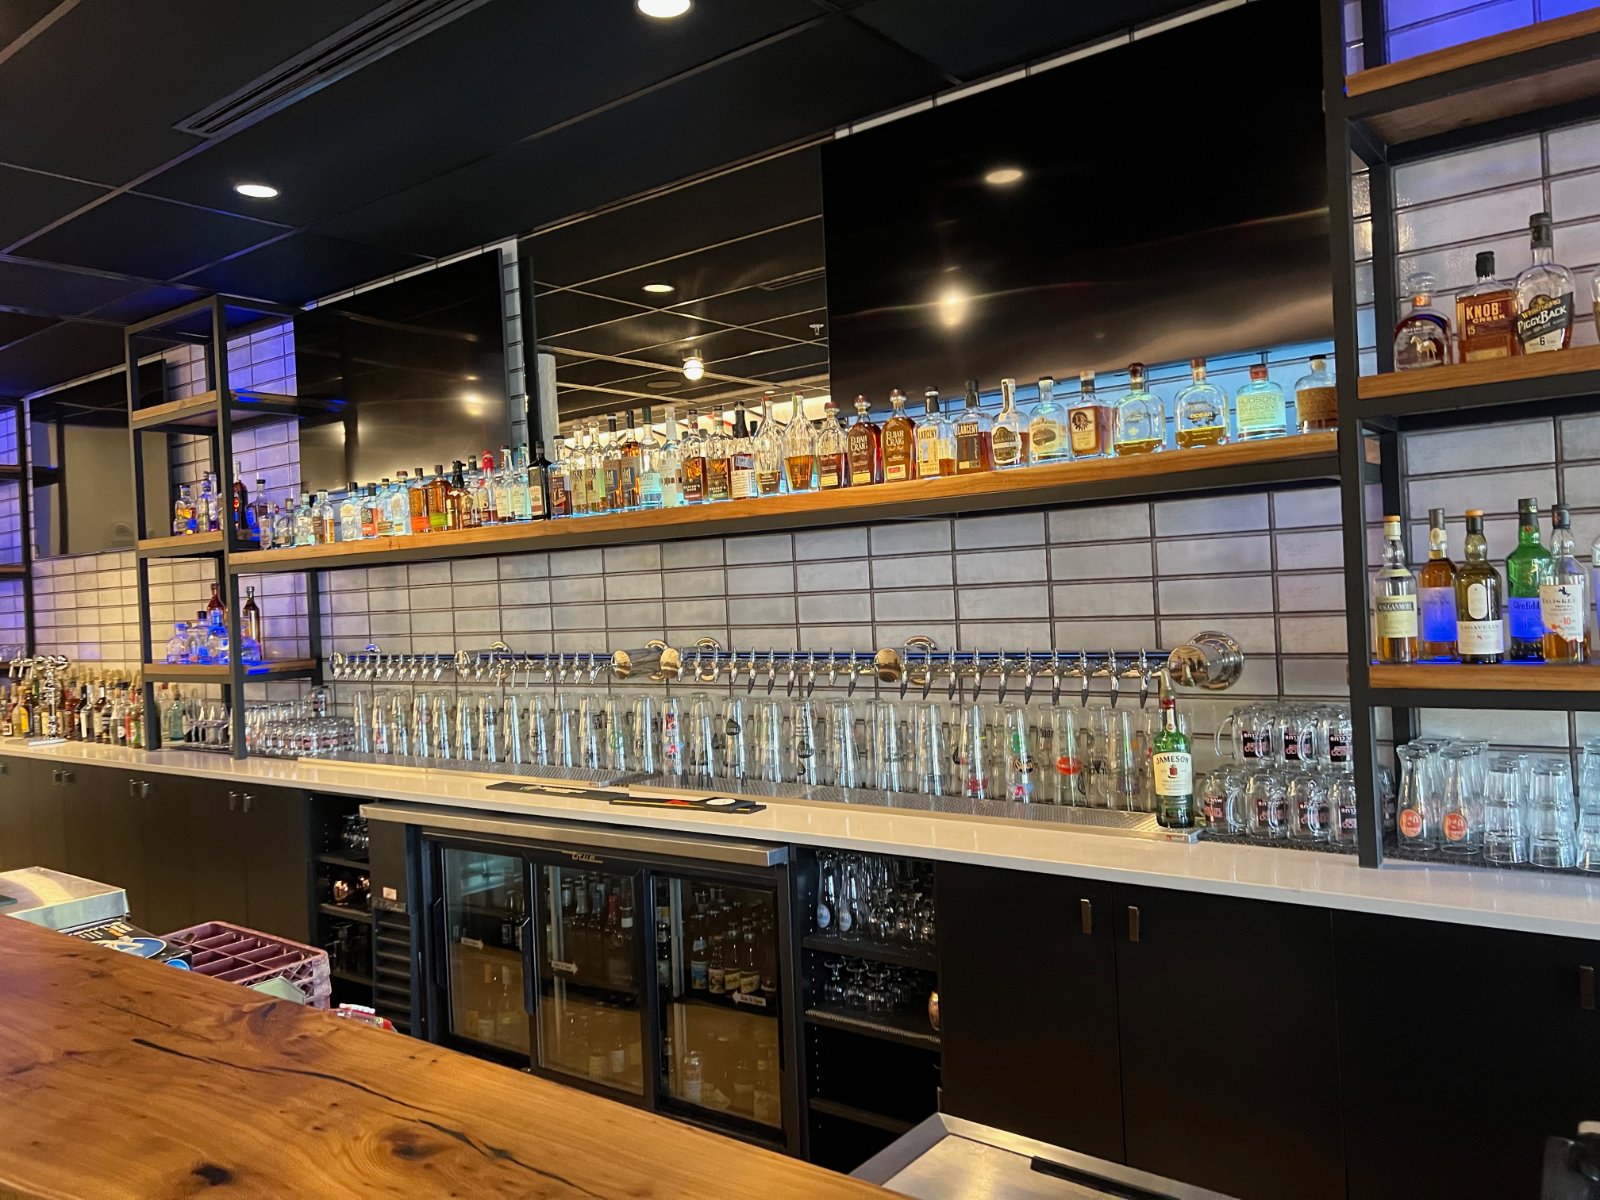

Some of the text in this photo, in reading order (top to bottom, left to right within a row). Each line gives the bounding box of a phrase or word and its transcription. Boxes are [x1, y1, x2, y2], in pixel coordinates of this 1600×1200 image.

[1466, 302, 1499, 320] KNOB
[1472, 313, 1505, 323] CREEK
[1539, 336, 1546, 346] 6
[886, 437, 905, 446] CRAIG
[1513, 600, 1541, 610] Glenfidd
[1563, 616, 1572, 625] 10
[1156, 755, 1189, 765] JAMESON
